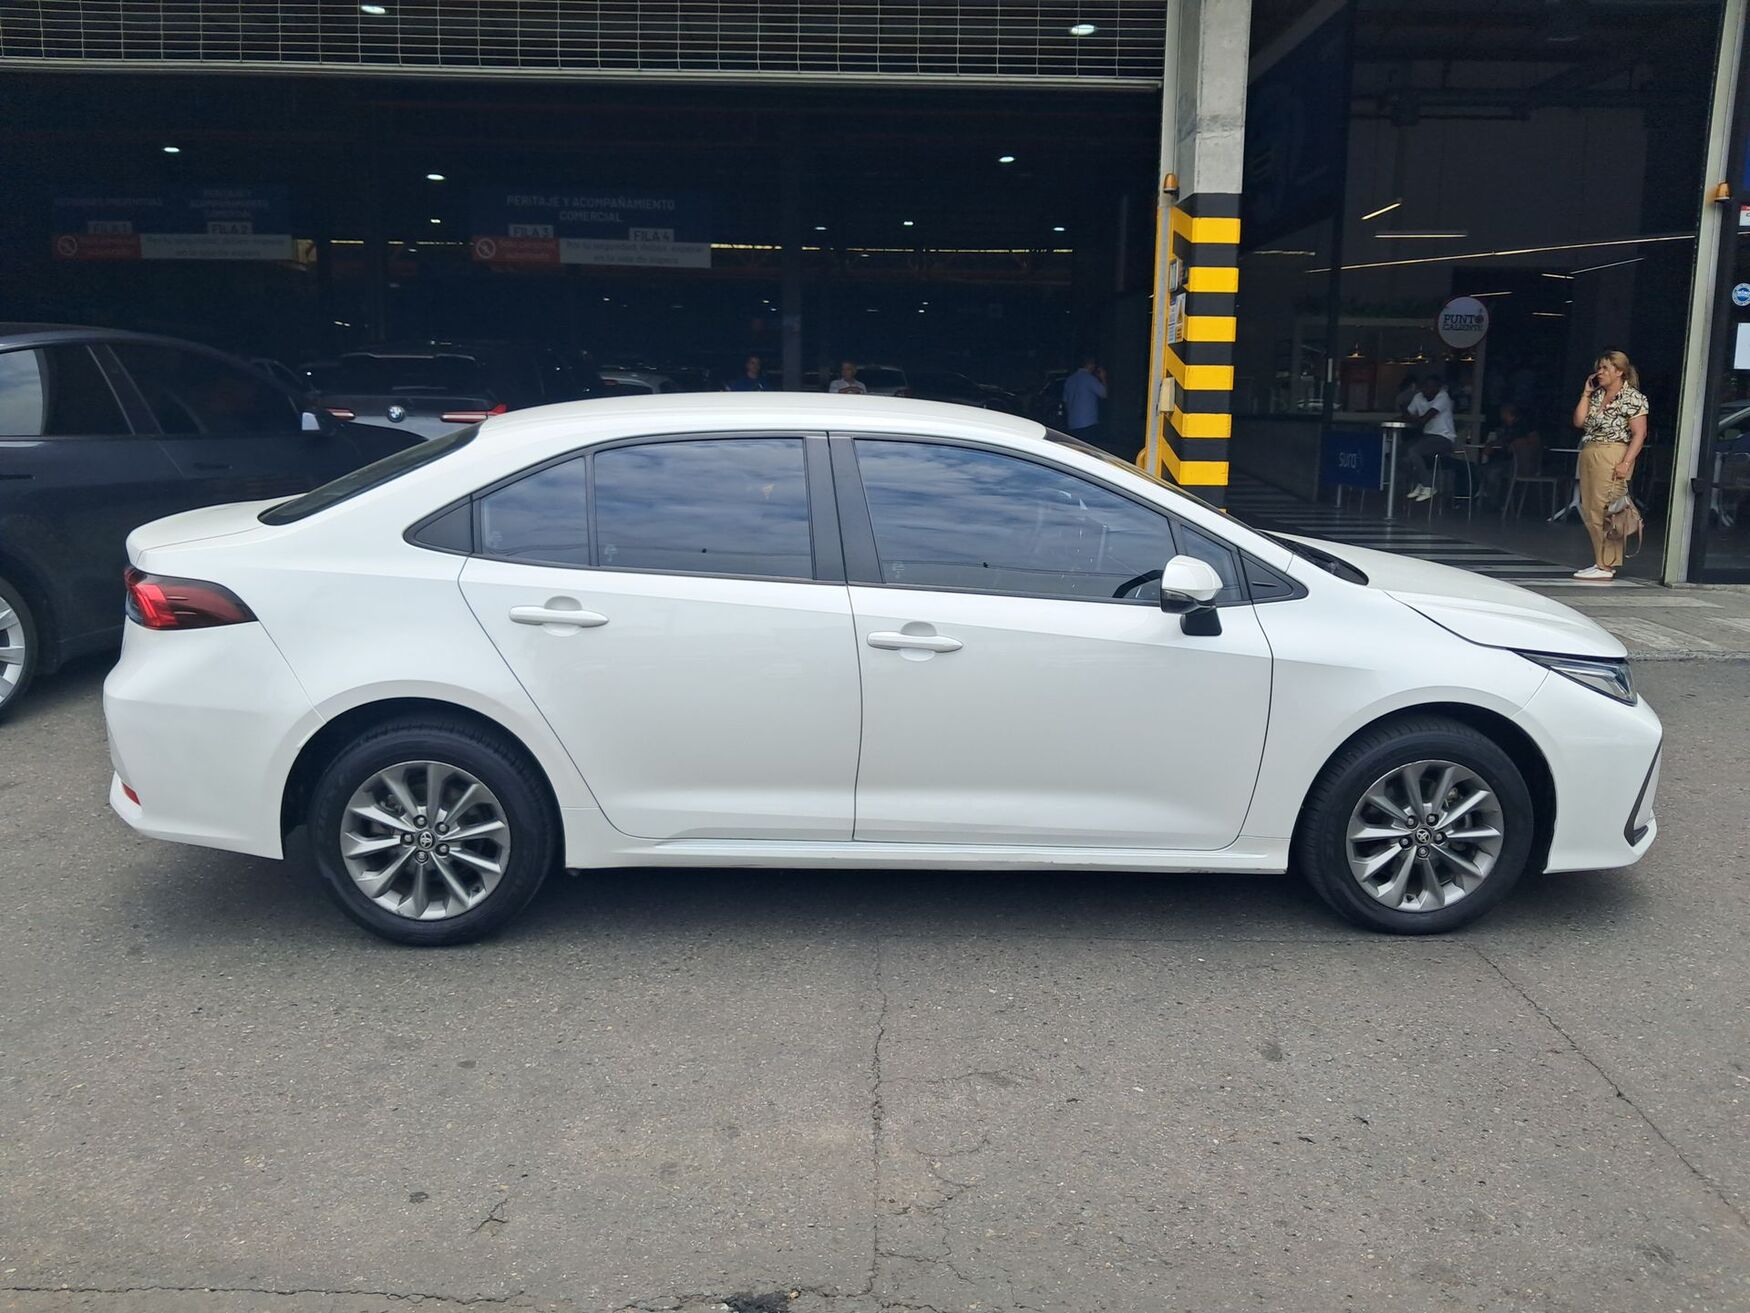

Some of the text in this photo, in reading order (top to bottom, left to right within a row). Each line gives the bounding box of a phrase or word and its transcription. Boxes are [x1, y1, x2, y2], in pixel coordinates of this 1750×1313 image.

[506, 195, 561, 208] PERITAJE
[572, 195, 675, 211] ACOMPAÑAMIENTO
[559, 210, 622, 222] COMERCIAL
[513, 227, 540, 238] FILA
[633, 230, 670, 242] FILA 4
